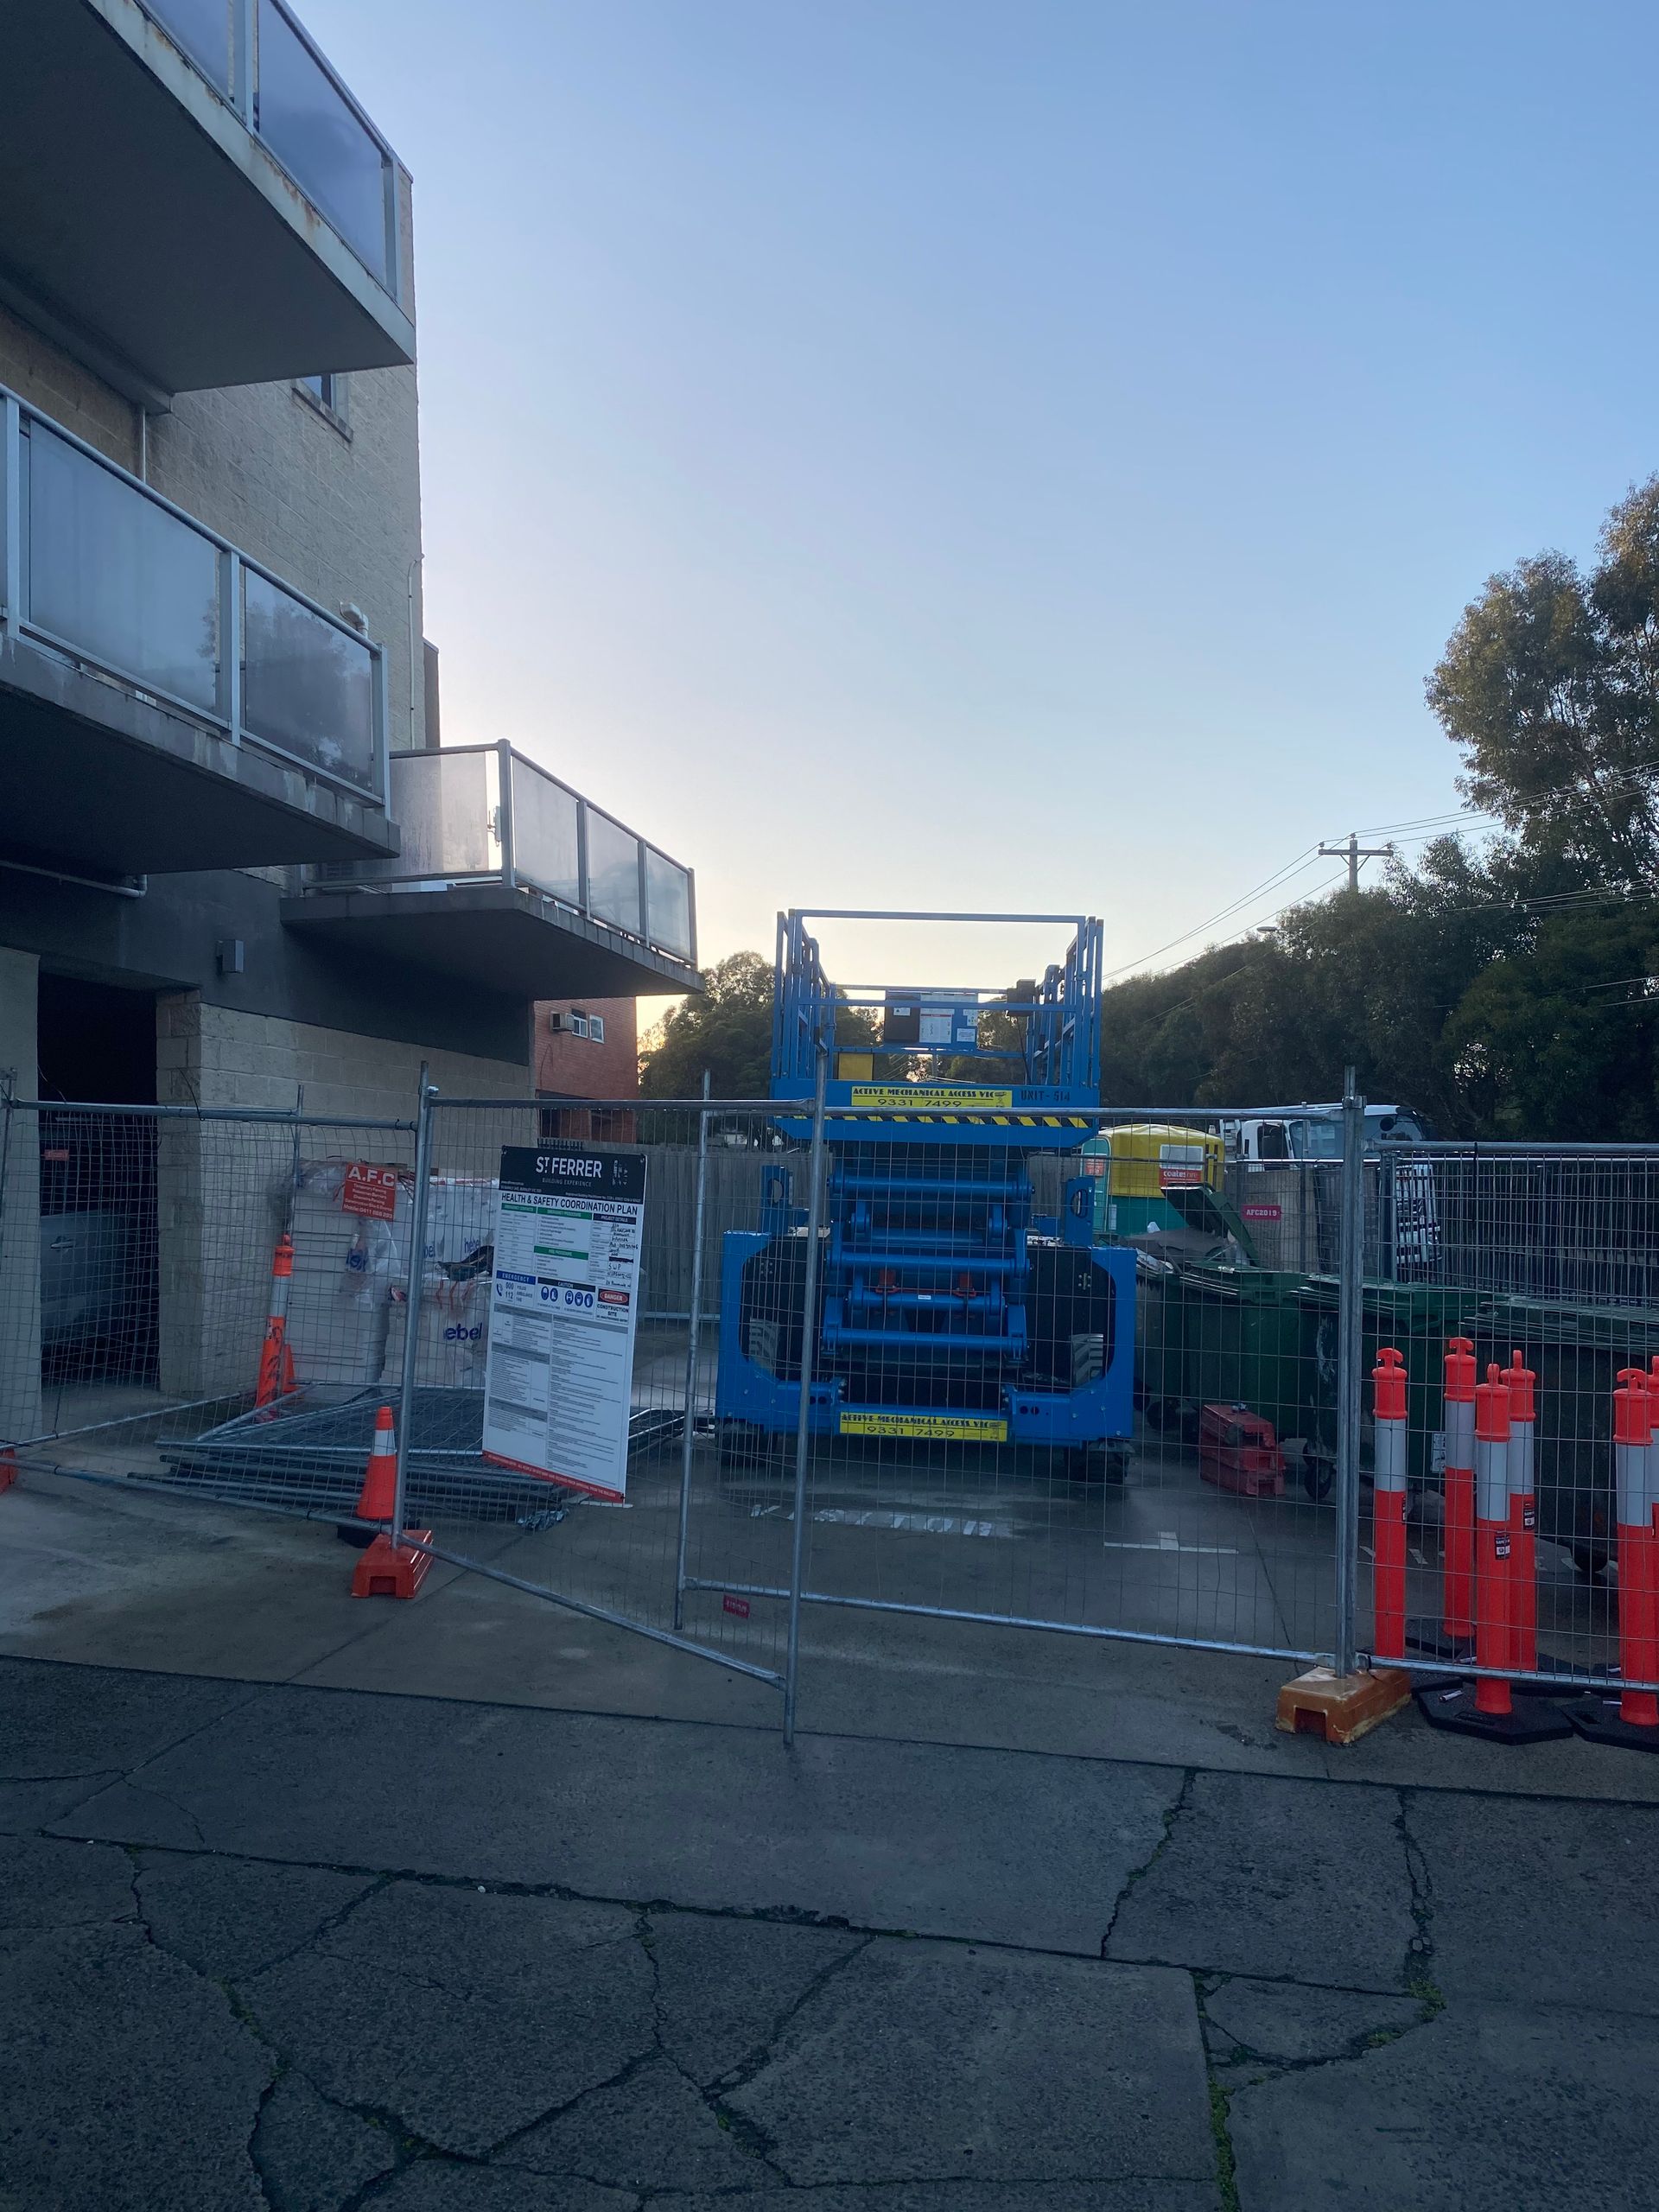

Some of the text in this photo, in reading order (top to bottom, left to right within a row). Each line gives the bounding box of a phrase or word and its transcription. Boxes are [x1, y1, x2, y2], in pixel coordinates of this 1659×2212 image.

[887, 1089, 945, 1097] MECHANICAL
[877, 1098, 913, 1107] 9331
[551, 1157, 602, 1178] FERRER
[348, 1166, 394, 1187] A.F.C
[542, 1177, 592, 1187] BUILDING EXPERIENCE
[501, 1192, 526, 1204] HEALTH
[533, 1197, 558, 1207] SAFETY
[560, 1198, 615, 1212] COORDINATION
[616, 1205, 638, 1215] PLAN
[502, 1272, 530, 1282] EMERGENCY
[604, 1293, 623, 1301] DANGER
[597, 1303, 629, 1313] CONSTRUCTION
[443, 1322, 483, 1341] ebel
[842, 1414, 874, 1422] ACTIVE
[878, 1415, 937, 1426] MECHANICAL
[941, 1419, 969, 1427] ACCESS
[867, 1426, 904, 1435] 9331
[915, 1428, 955, 1438] 7499
